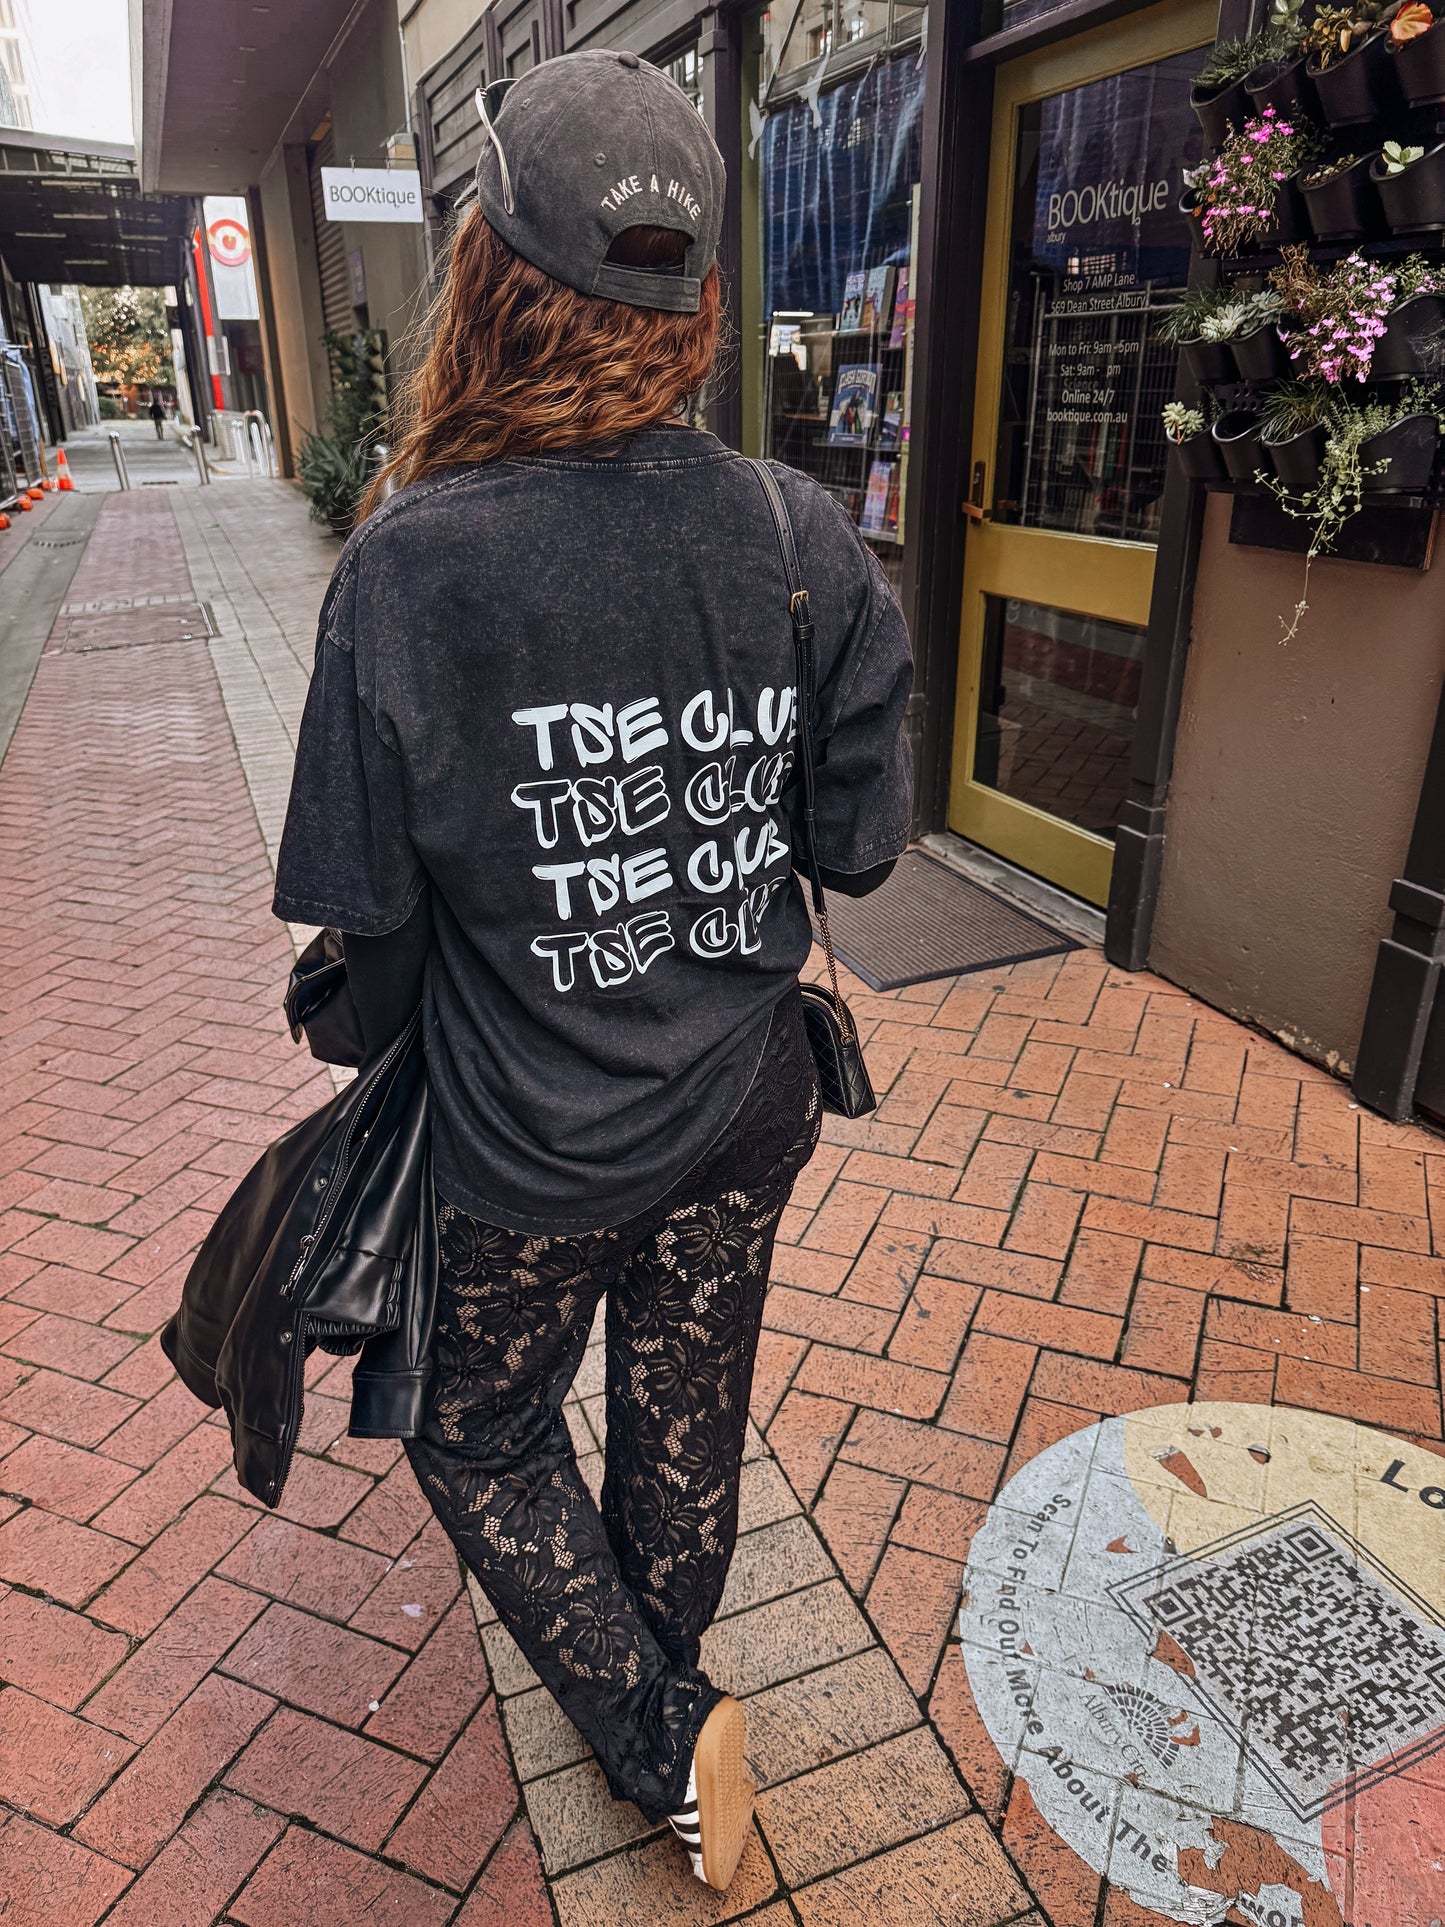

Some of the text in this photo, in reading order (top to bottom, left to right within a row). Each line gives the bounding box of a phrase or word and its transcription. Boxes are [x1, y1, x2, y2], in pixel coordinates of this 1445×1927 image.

[330, 185, 415, 208] BOOKtique
[600, 174, 701, 220] TAKE A HIKE
[1048, 179, 1169, 231] BOOKtique
[1047, 231, 1066, 243] albury
[1051, 293, 1146, 314] 569 Dean Street Albury
[1063, 273, 1135, 293] Shop 7 AMP Lane
[1049, 344, 1067, 356] Mon
[1068, 345, 1077, 355] to
[1079, 342, 1092, 354] Fri:
[1093, 341, 1112, 354] 9am
[1119, 340, 1139, 356] 5pm
[1060, 364, 1076, 377] Sat:
[1077, 363, 1095, 376] 9am
[1047, 408, 1128, 425] booktique.com.au
[1062, 388, 1116, 406] Online 24/7
[512, 686, 798, 771] TSE CLU
[511, 766, 671, 849] TSE
[531, 847, 674, 921] TSE
[530, 910, 676, 992] TSE
[1027, 1493, 1072, 1533] Scan
[1012, 1538, 1039, 1560] To
[997, 1565, 1027, 1611] Find
[1005, 1669, 1044, 1736] More
[1037, 1745, 1111, 1824] About
[1115, 1818, 1168, 1874] The
